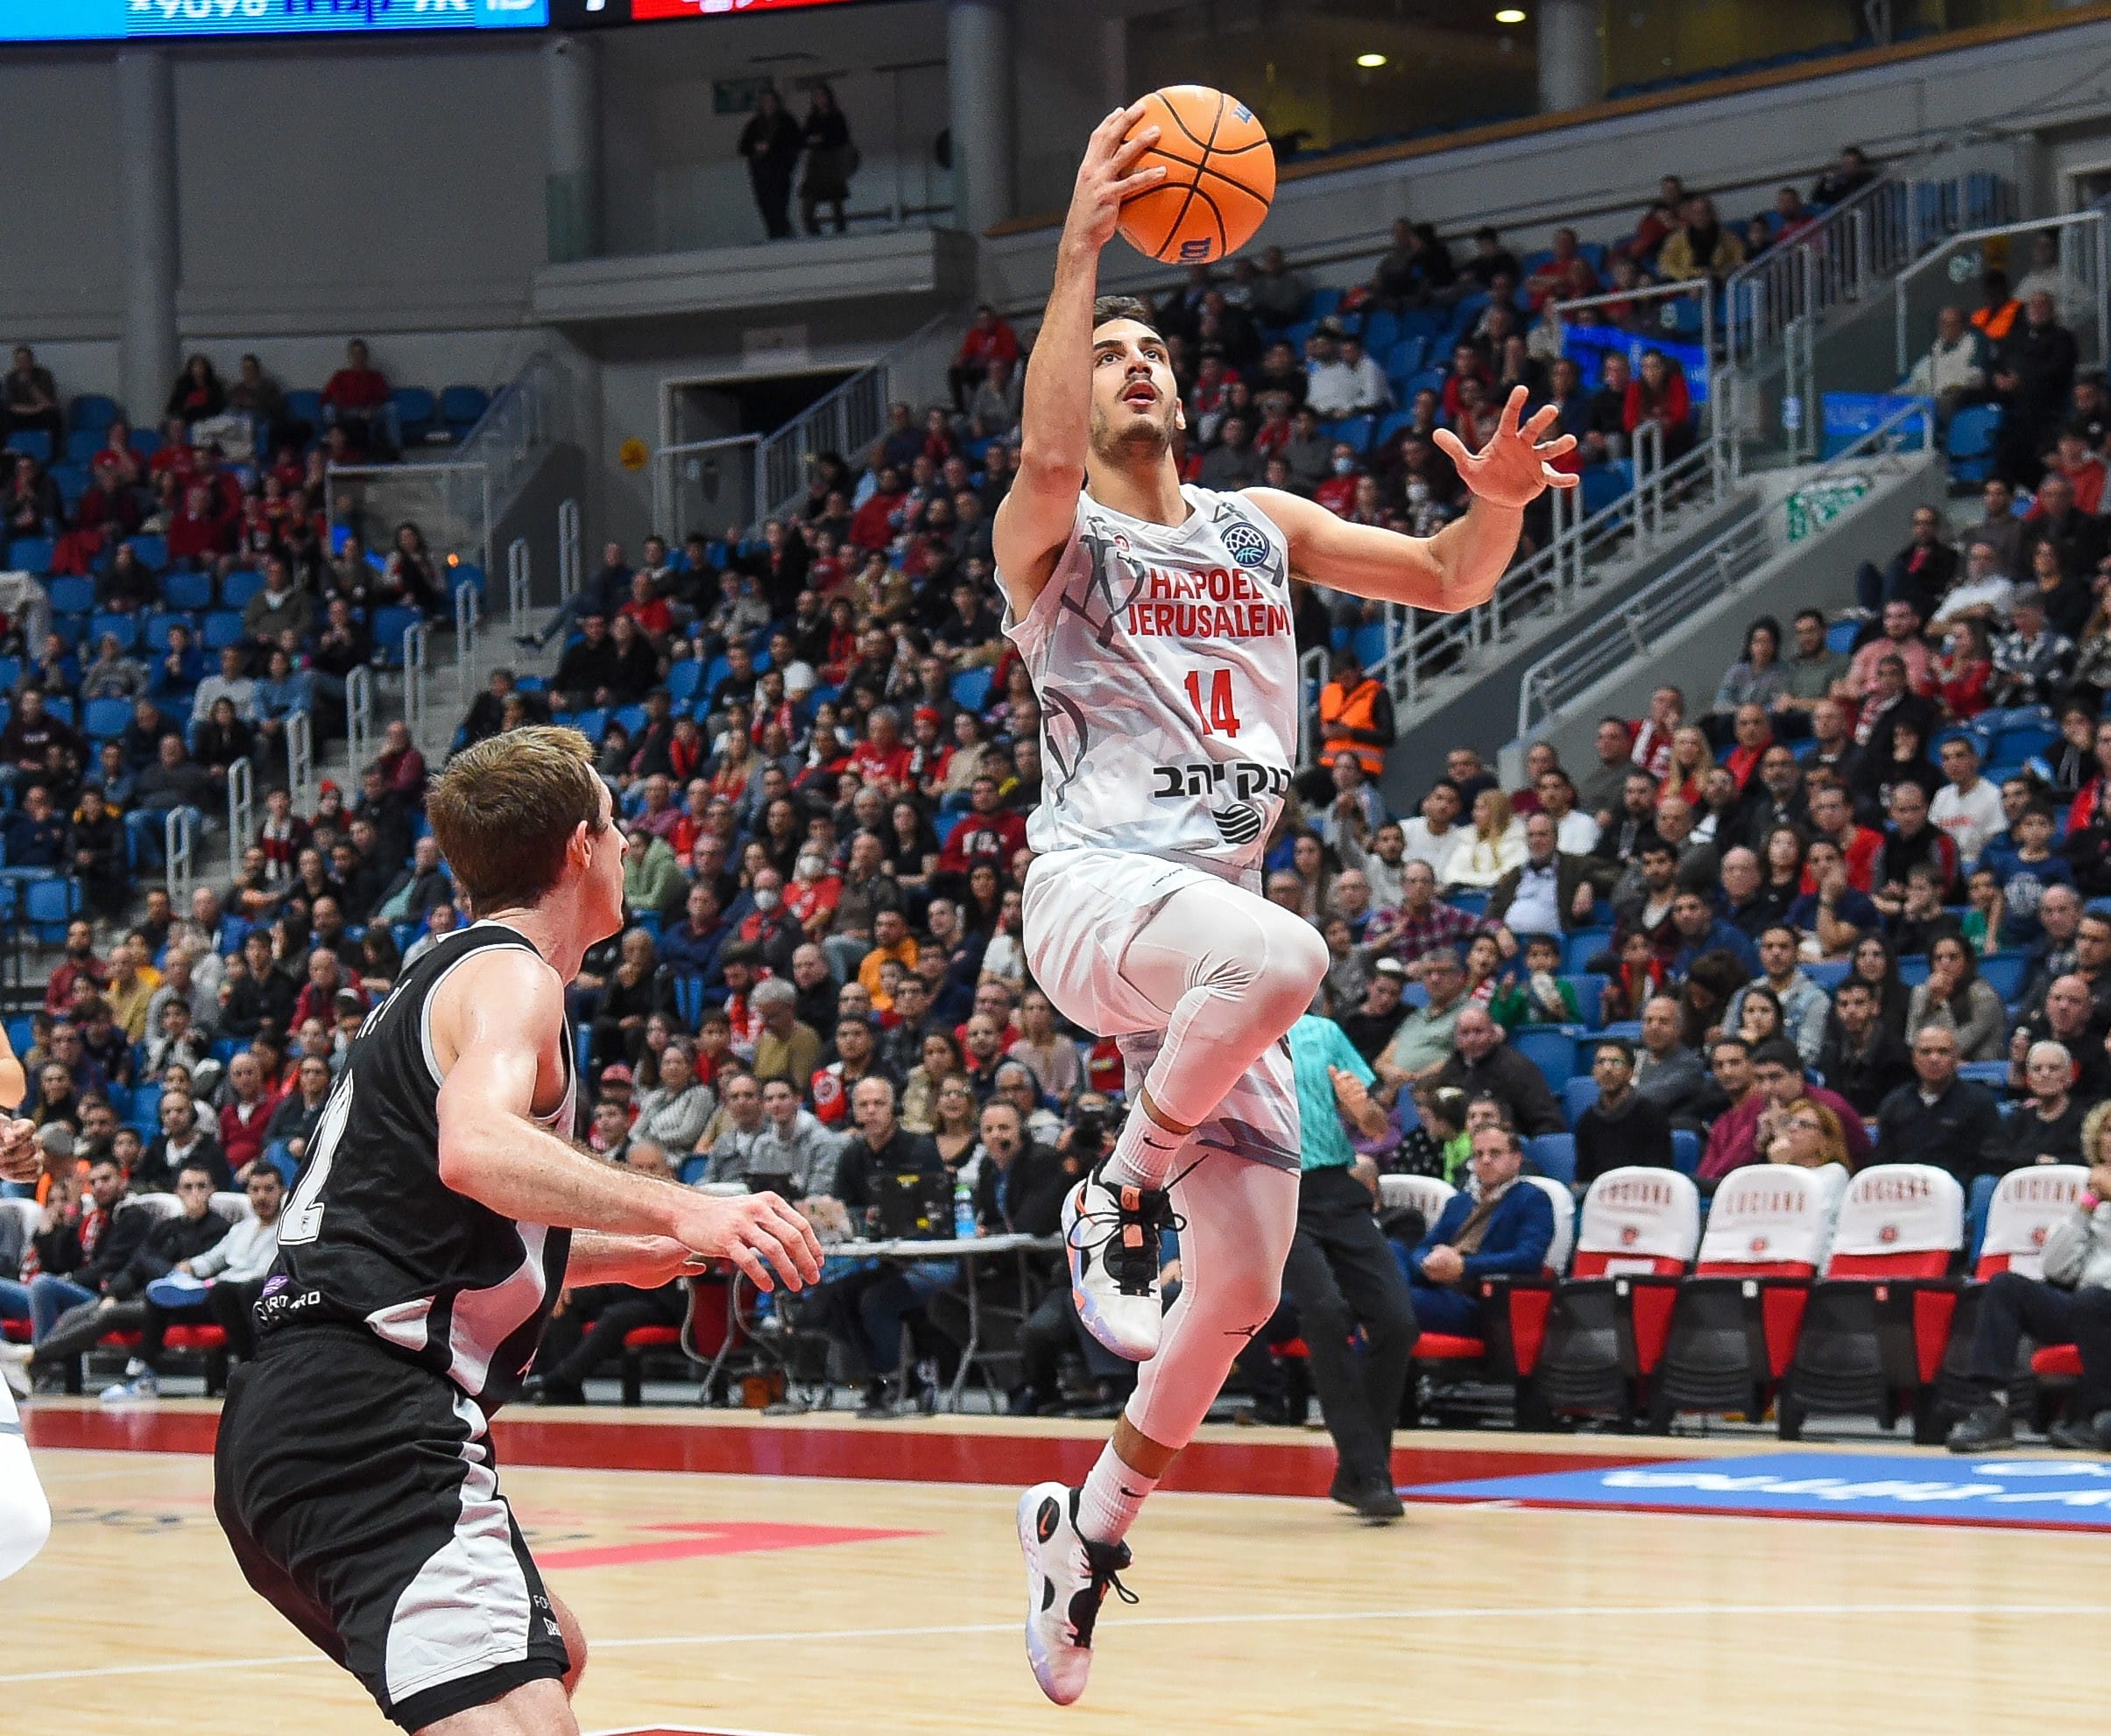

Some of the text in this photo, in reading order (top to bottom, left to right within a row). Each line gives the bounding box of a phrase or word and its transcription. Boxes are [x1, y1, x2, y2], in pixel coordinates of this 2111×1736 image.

[1150, 568, 1264, 602] HAPOEL
[1127, 603, 1291, 638] JERUSALEM
[1184, 669, 1240, 738] 14
[1153, 763, 1225, 799] יהב
